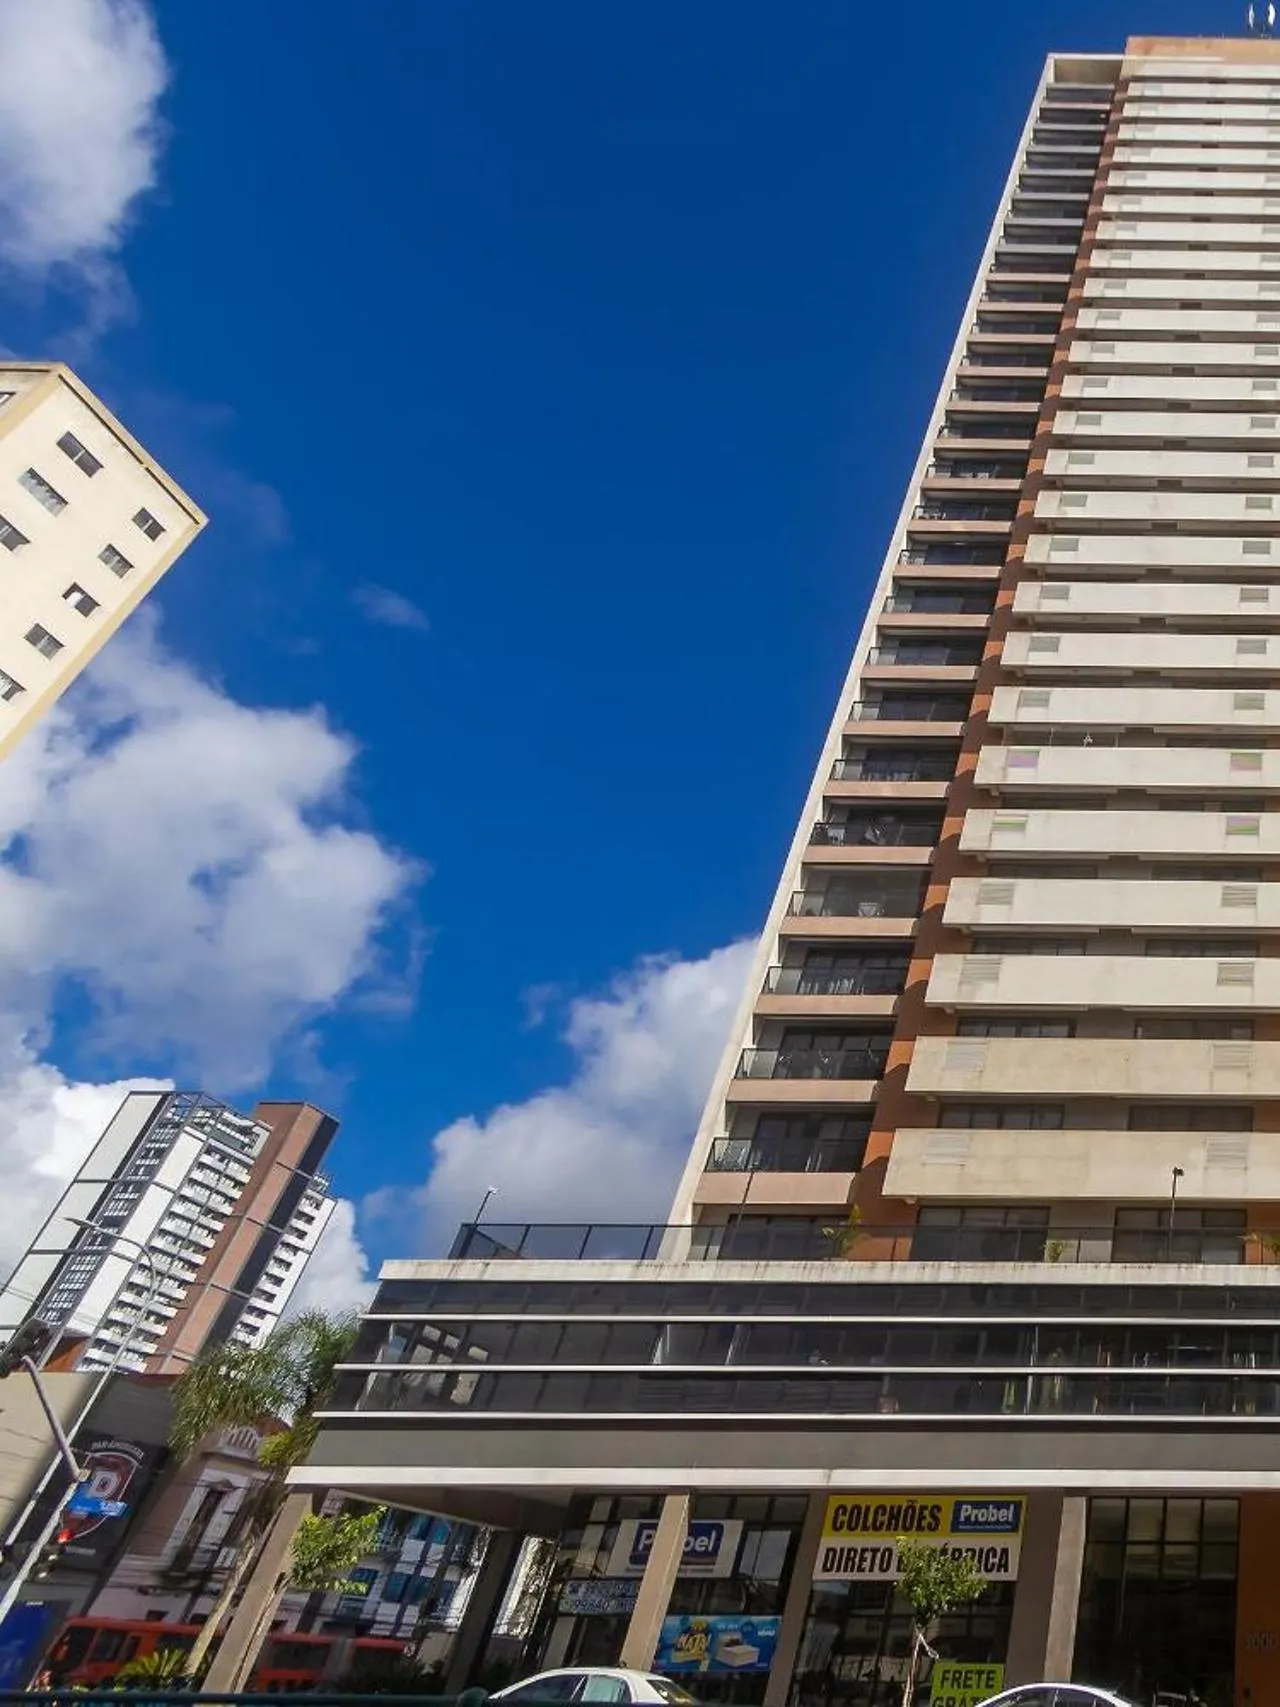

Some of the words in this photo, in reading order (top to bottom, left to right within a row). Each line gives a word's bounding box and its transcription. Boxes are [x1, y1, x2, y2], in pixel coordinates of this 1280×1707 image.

[832, 1500, 942, 1532] COLCHÕES
[959, 1503, 1014, 1523] Probel
[638, 1529, 716, 1552] Pbel
[822, 1547, 892, 1573] DIRETO
[940, 1669, 997, 1689] FRETE
